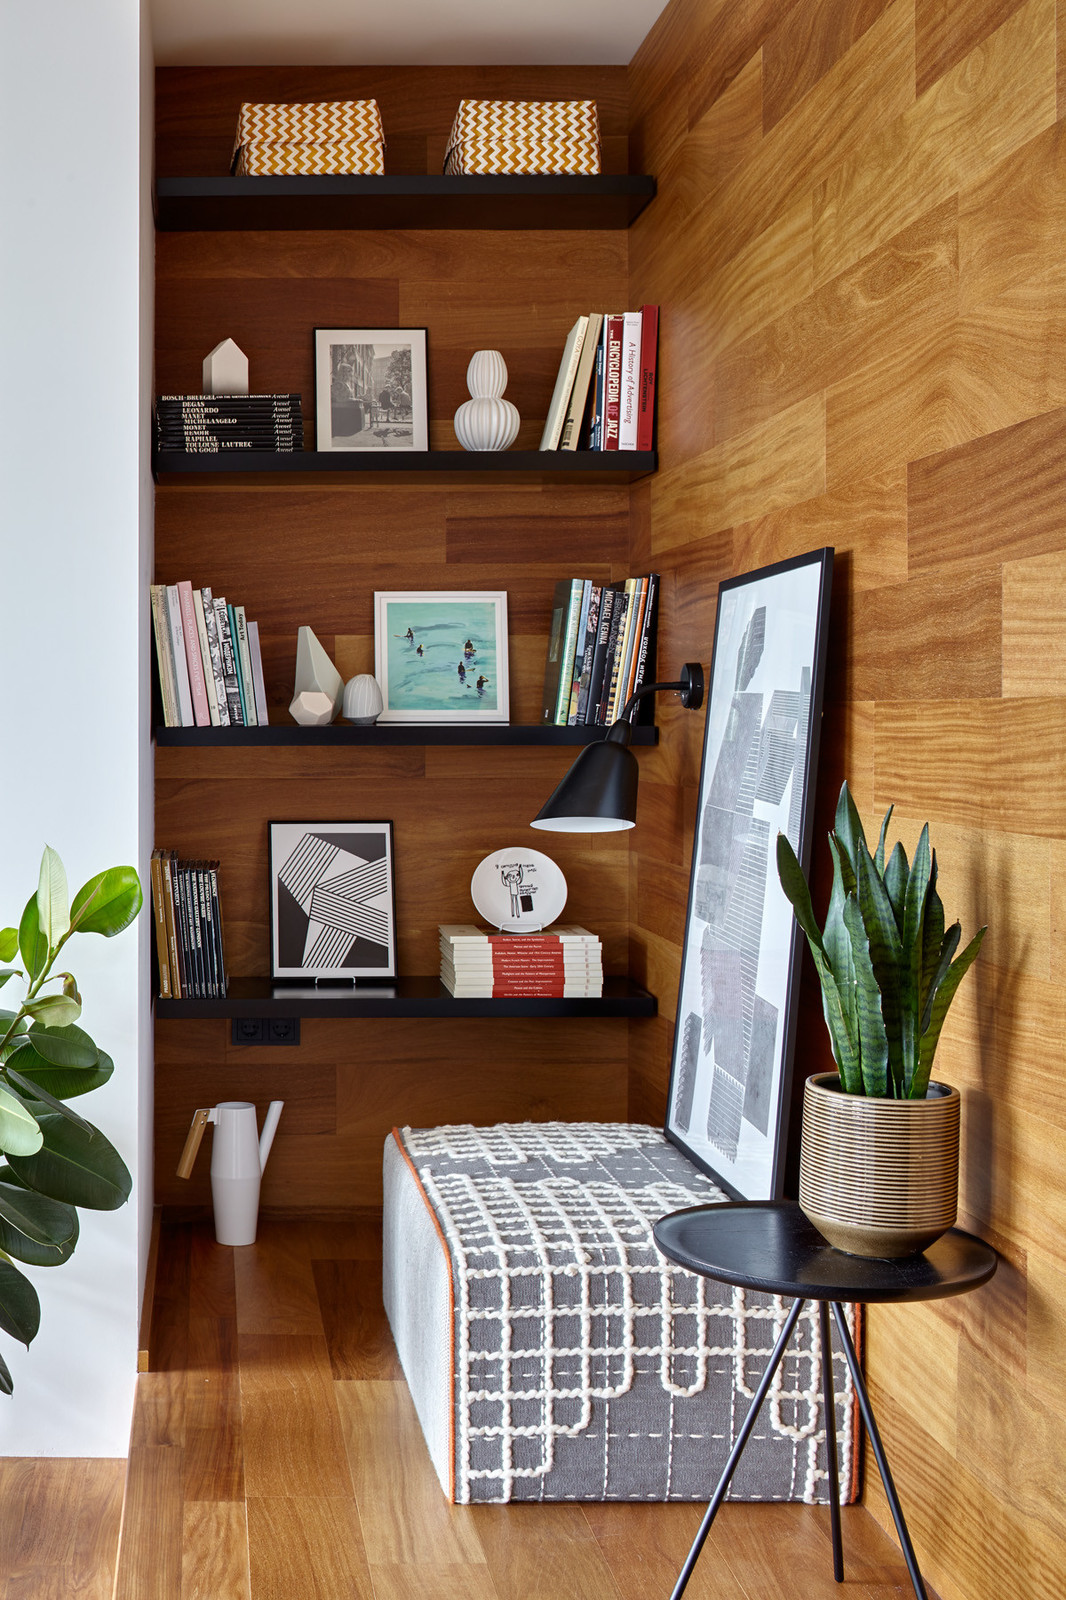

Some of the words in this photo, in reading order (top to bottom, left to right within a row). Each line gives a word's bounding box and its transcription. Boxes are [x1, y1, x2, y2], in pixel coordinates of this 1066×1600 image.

[608, 340, 620, 403] ENCYCLOPEDIA
[626, 350, 636, 374] History
[626, 376, 635, 384] of
[608, 405, 618, 416] OF
[623, 385, 634, 424] Advertising
[607, 418, 618, 439] JAZZ
[602, 590, 614, 620] MICHAEL
[613, 598, 623, 620] BRIAN
[598, 622, 610, 645] KENNA
[609, 620, 618, 653] JUNGEN
[223, 642, 234, 675] МОДЕРНИЗМ
[639, 636, 649, 663] Уорхол
[636, 664, 645, 684] Энди
